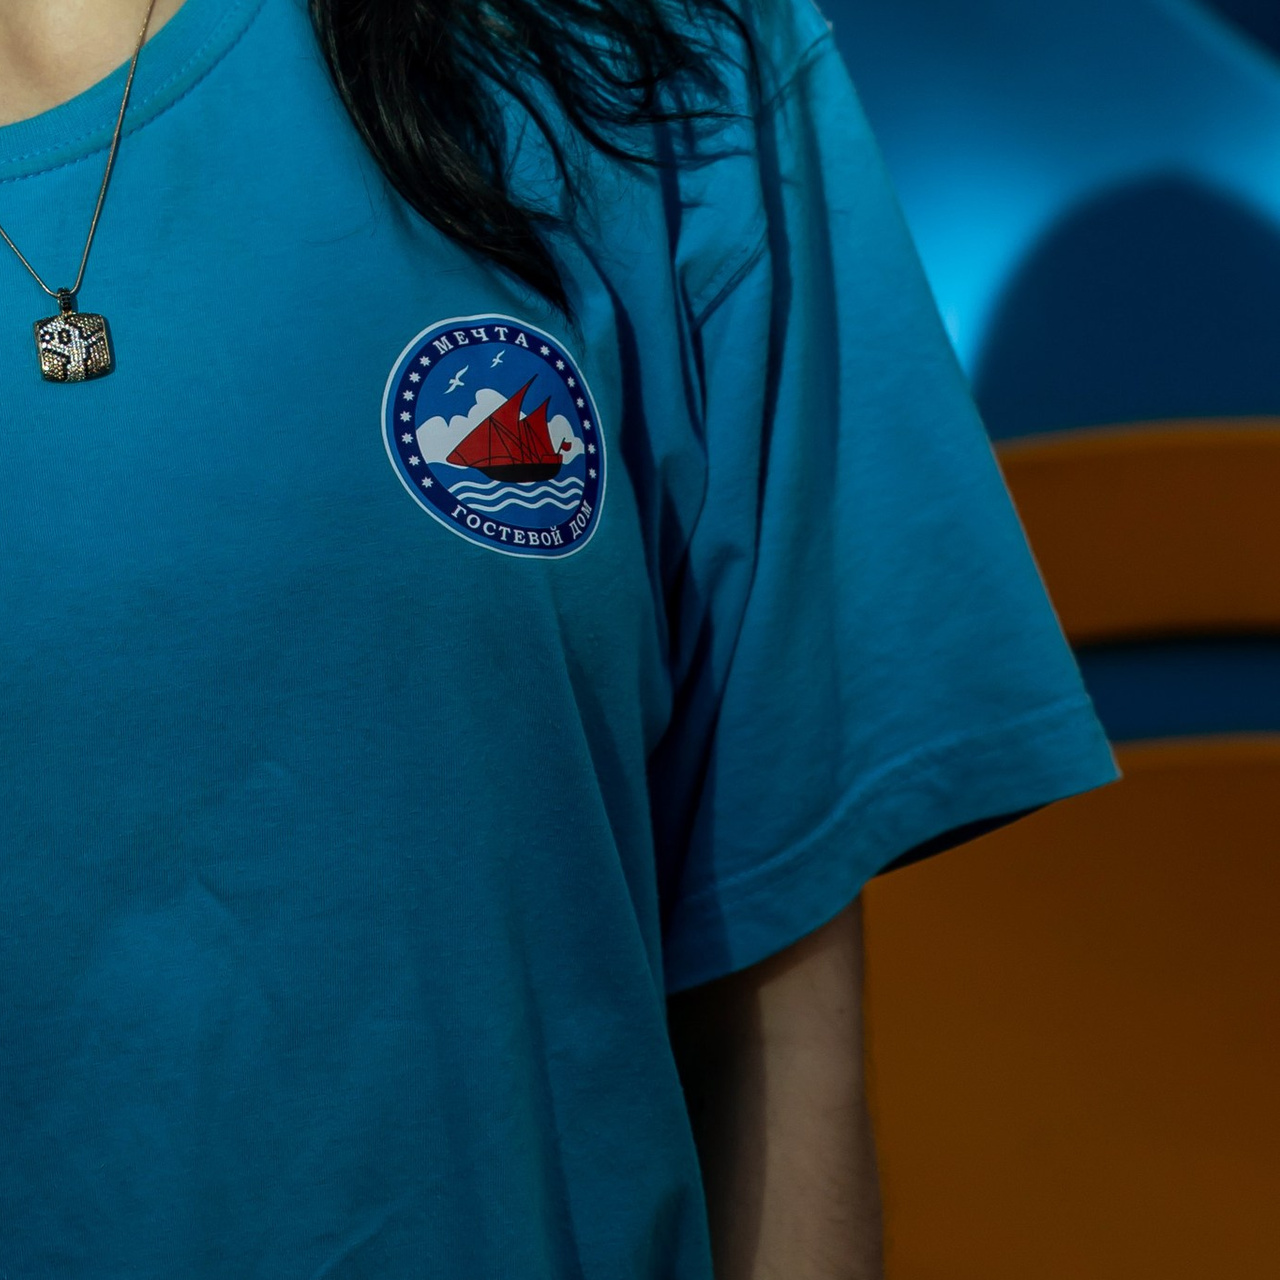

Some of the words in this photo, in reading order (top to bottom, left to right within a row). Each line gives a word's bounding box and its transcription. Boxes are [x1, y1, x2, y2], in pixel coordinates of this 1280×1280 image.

[432, 326, 530, 355] МЕЧТА
[451, 504, 564, 546] ГОСТЕВОЙ
[569, 499, 593, 540] ДОМ
